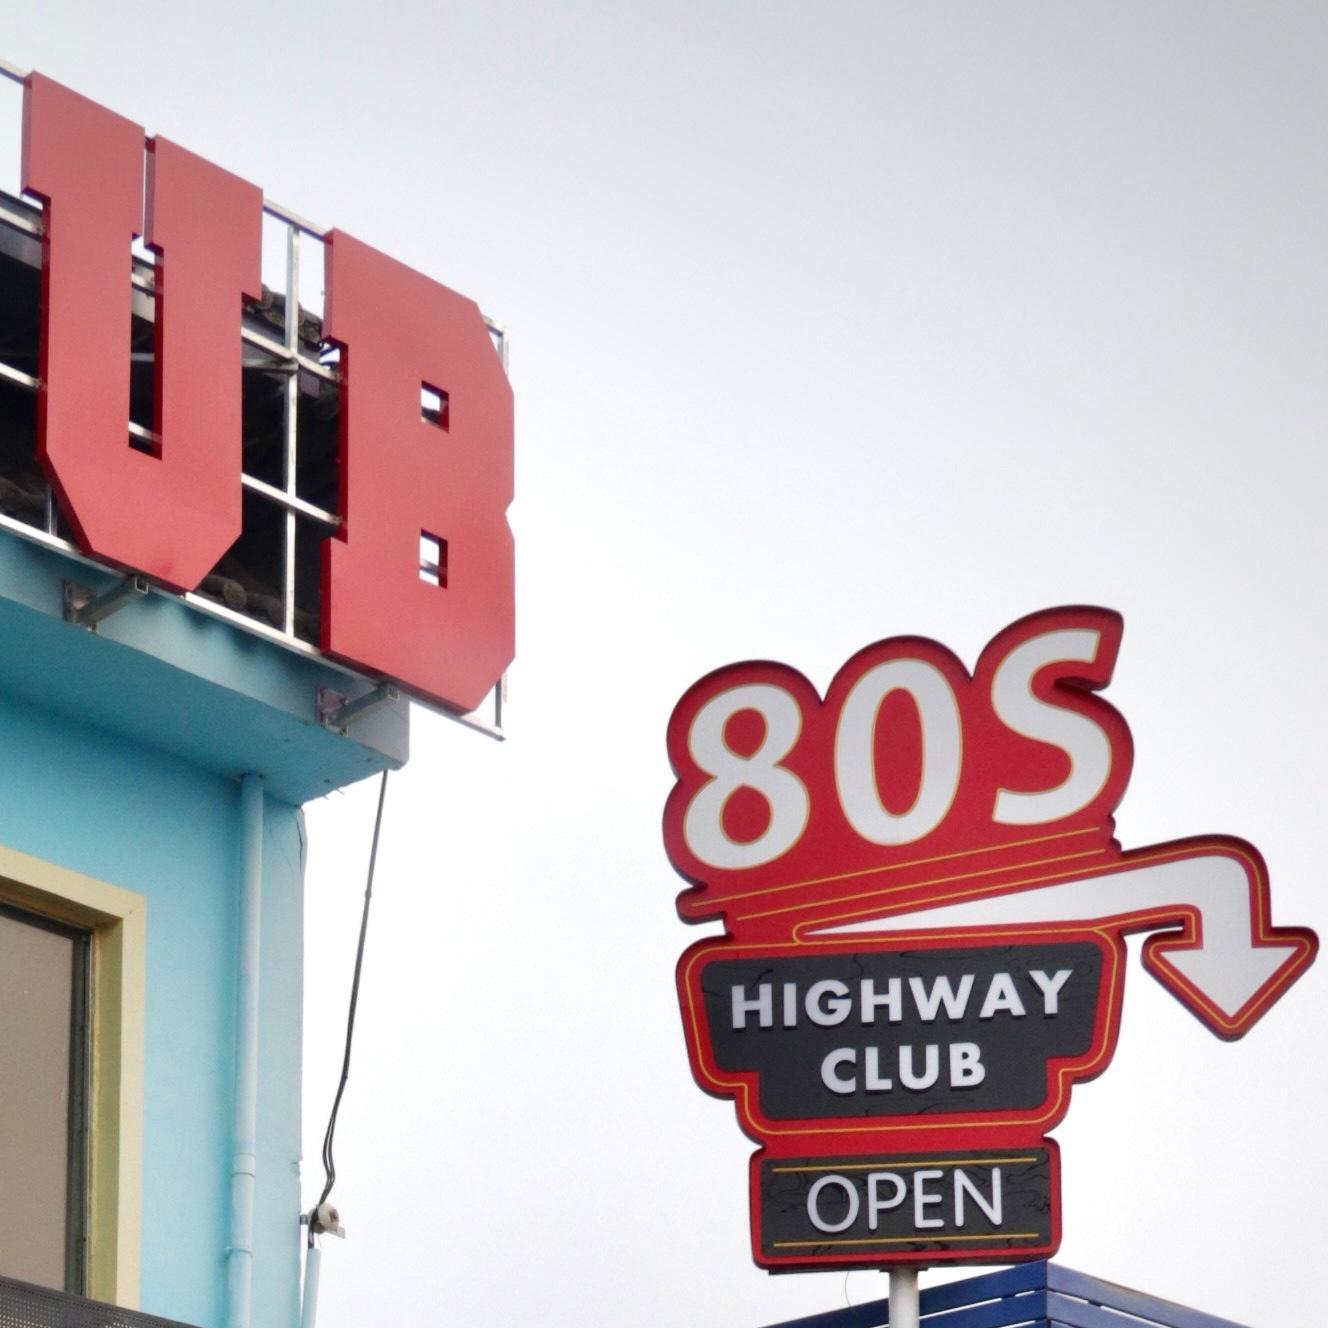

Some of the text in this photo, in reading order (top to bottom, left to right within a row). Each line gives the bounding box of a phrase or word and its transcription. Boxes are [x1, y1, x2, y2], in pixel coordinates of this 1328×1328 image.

[683, 628, 1112, 870] 80S
[731, 969, 1073, 1031] HIGHWAY
[820, 1041, 987, 1095] CLUB
[806, 1166, 1004, 1235] OPEN
